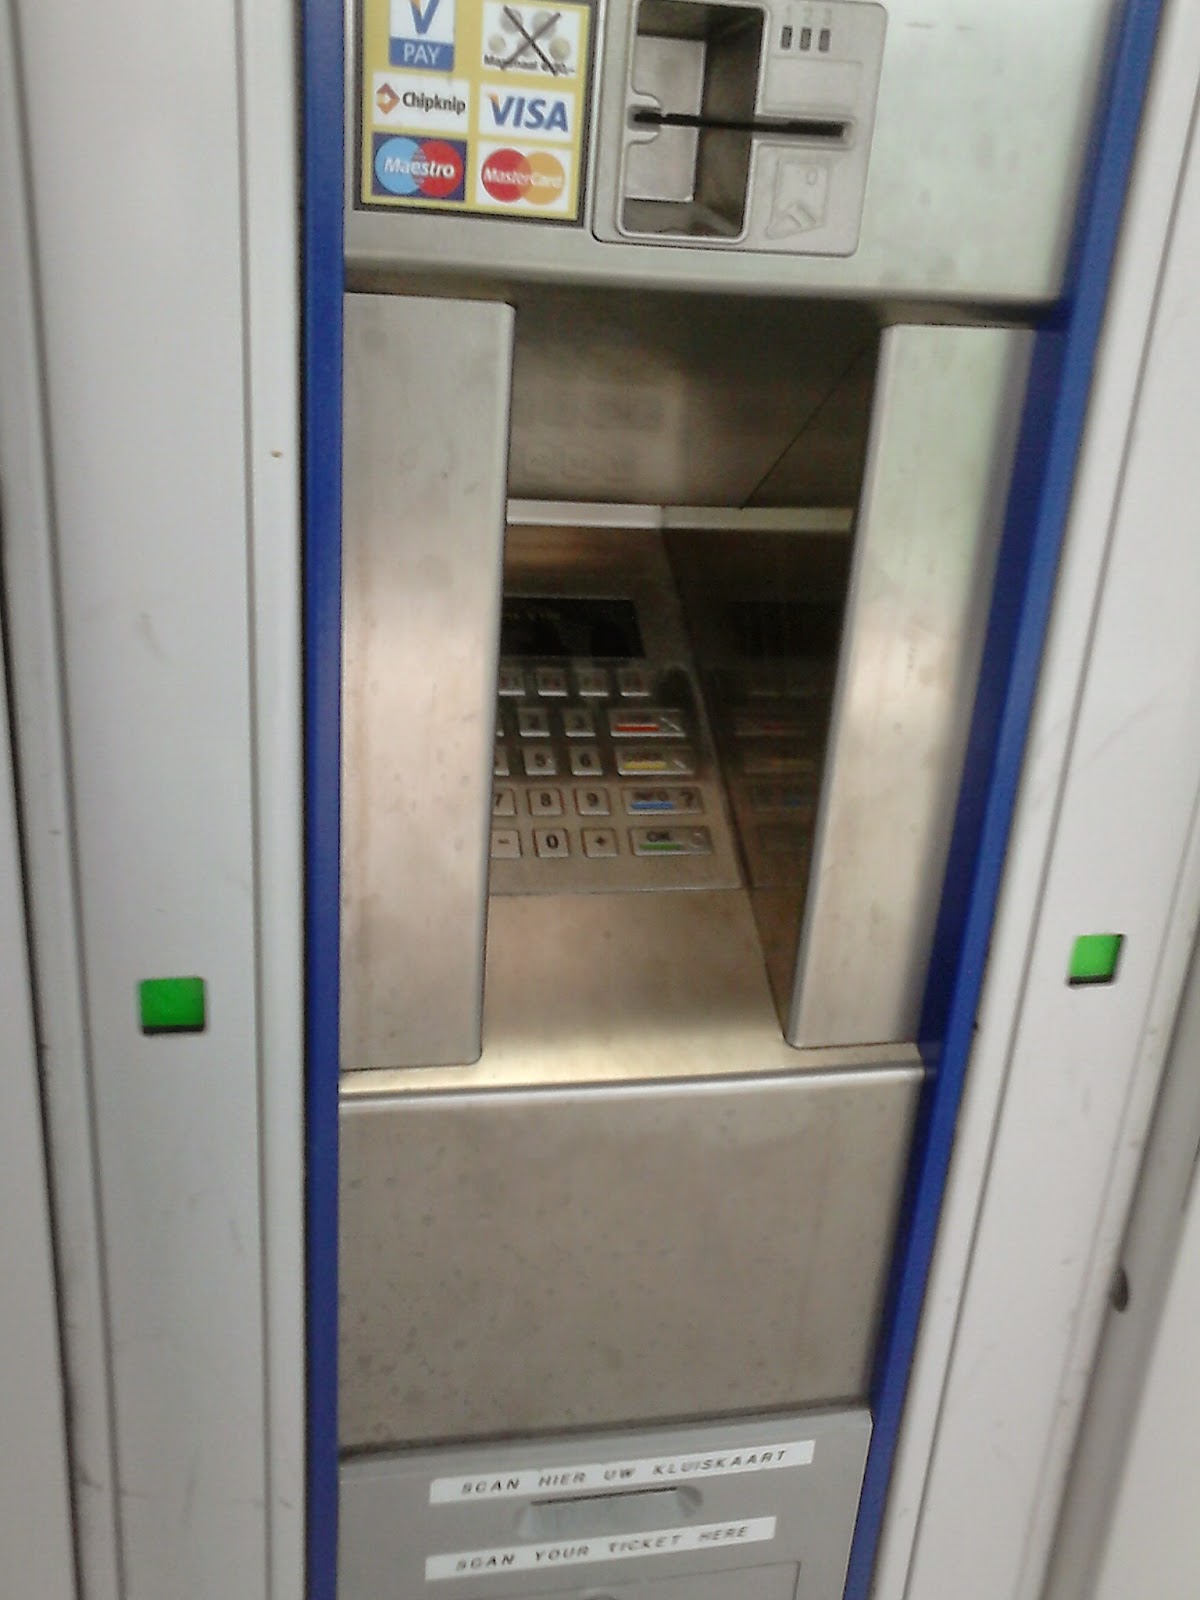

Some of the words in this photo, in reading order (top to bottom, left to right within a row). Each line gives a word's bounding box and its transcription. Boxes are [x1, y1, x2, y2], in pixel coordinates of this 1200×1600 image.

[403, 43, 440, 66] PAY
[402, 91, 466, 116] Chipknip
[487, 92, 569, 132] VISA
[384, 157, 455, 178] Maestro
[483, 169, 562, 189] MasterCard
[546, 833, 559, 849] 0
[461, 1477, 521, 1495] SCAN
[537, 1471, 587, 1488] HIER
[603, 1467, 636, 1482] UW
[651, 1449, 787, 1476] KLUISKAART
[455, 1553, 516, 1572] SCAN
[534, 1544, 591, 1562] YOUR
[608, 1534, 682, 1554] TICKET
[697, 1525, 749, 1542] HERE
